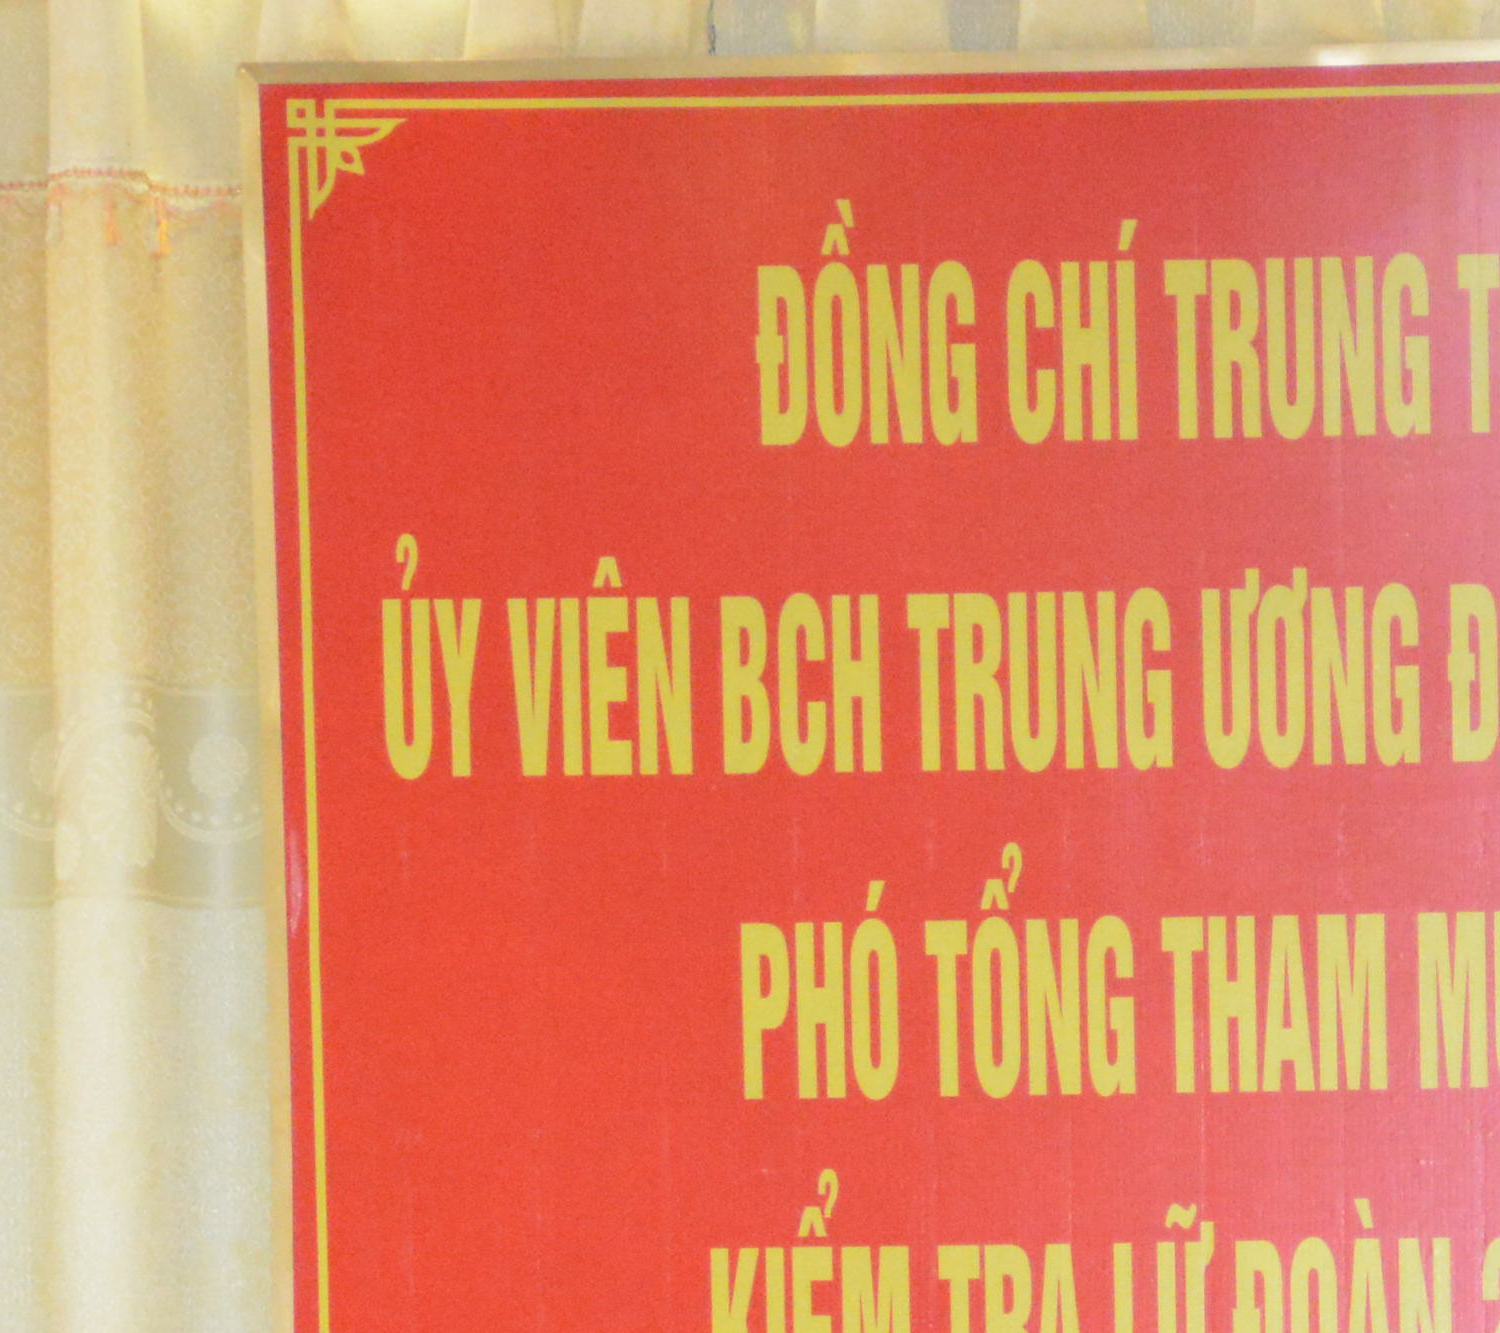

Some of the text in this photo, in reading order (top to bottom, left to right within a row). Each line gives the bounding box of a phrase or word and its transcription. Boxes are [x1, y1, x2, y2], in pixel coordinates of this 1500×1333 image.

[757, 203, 977, 445] ĐỒNG
[1008, 223, 1137, 443] CHÍ
[1166, 256, 1430, 438] TRUNG
[384, 536, 480, 778] ỦY
[509, 560, 692, 775] VIÊN
[722, 596, 881, 774] BCH
[908, 590, 1173, 771] TRUNG
[1203, 571, 1419, 767] ƯƠNG
[742, 884, 898, 1098] PHÓ
[926, 846, 1135, 1097] TỔNG
[1162, 916, 1386, 1091] THAM
